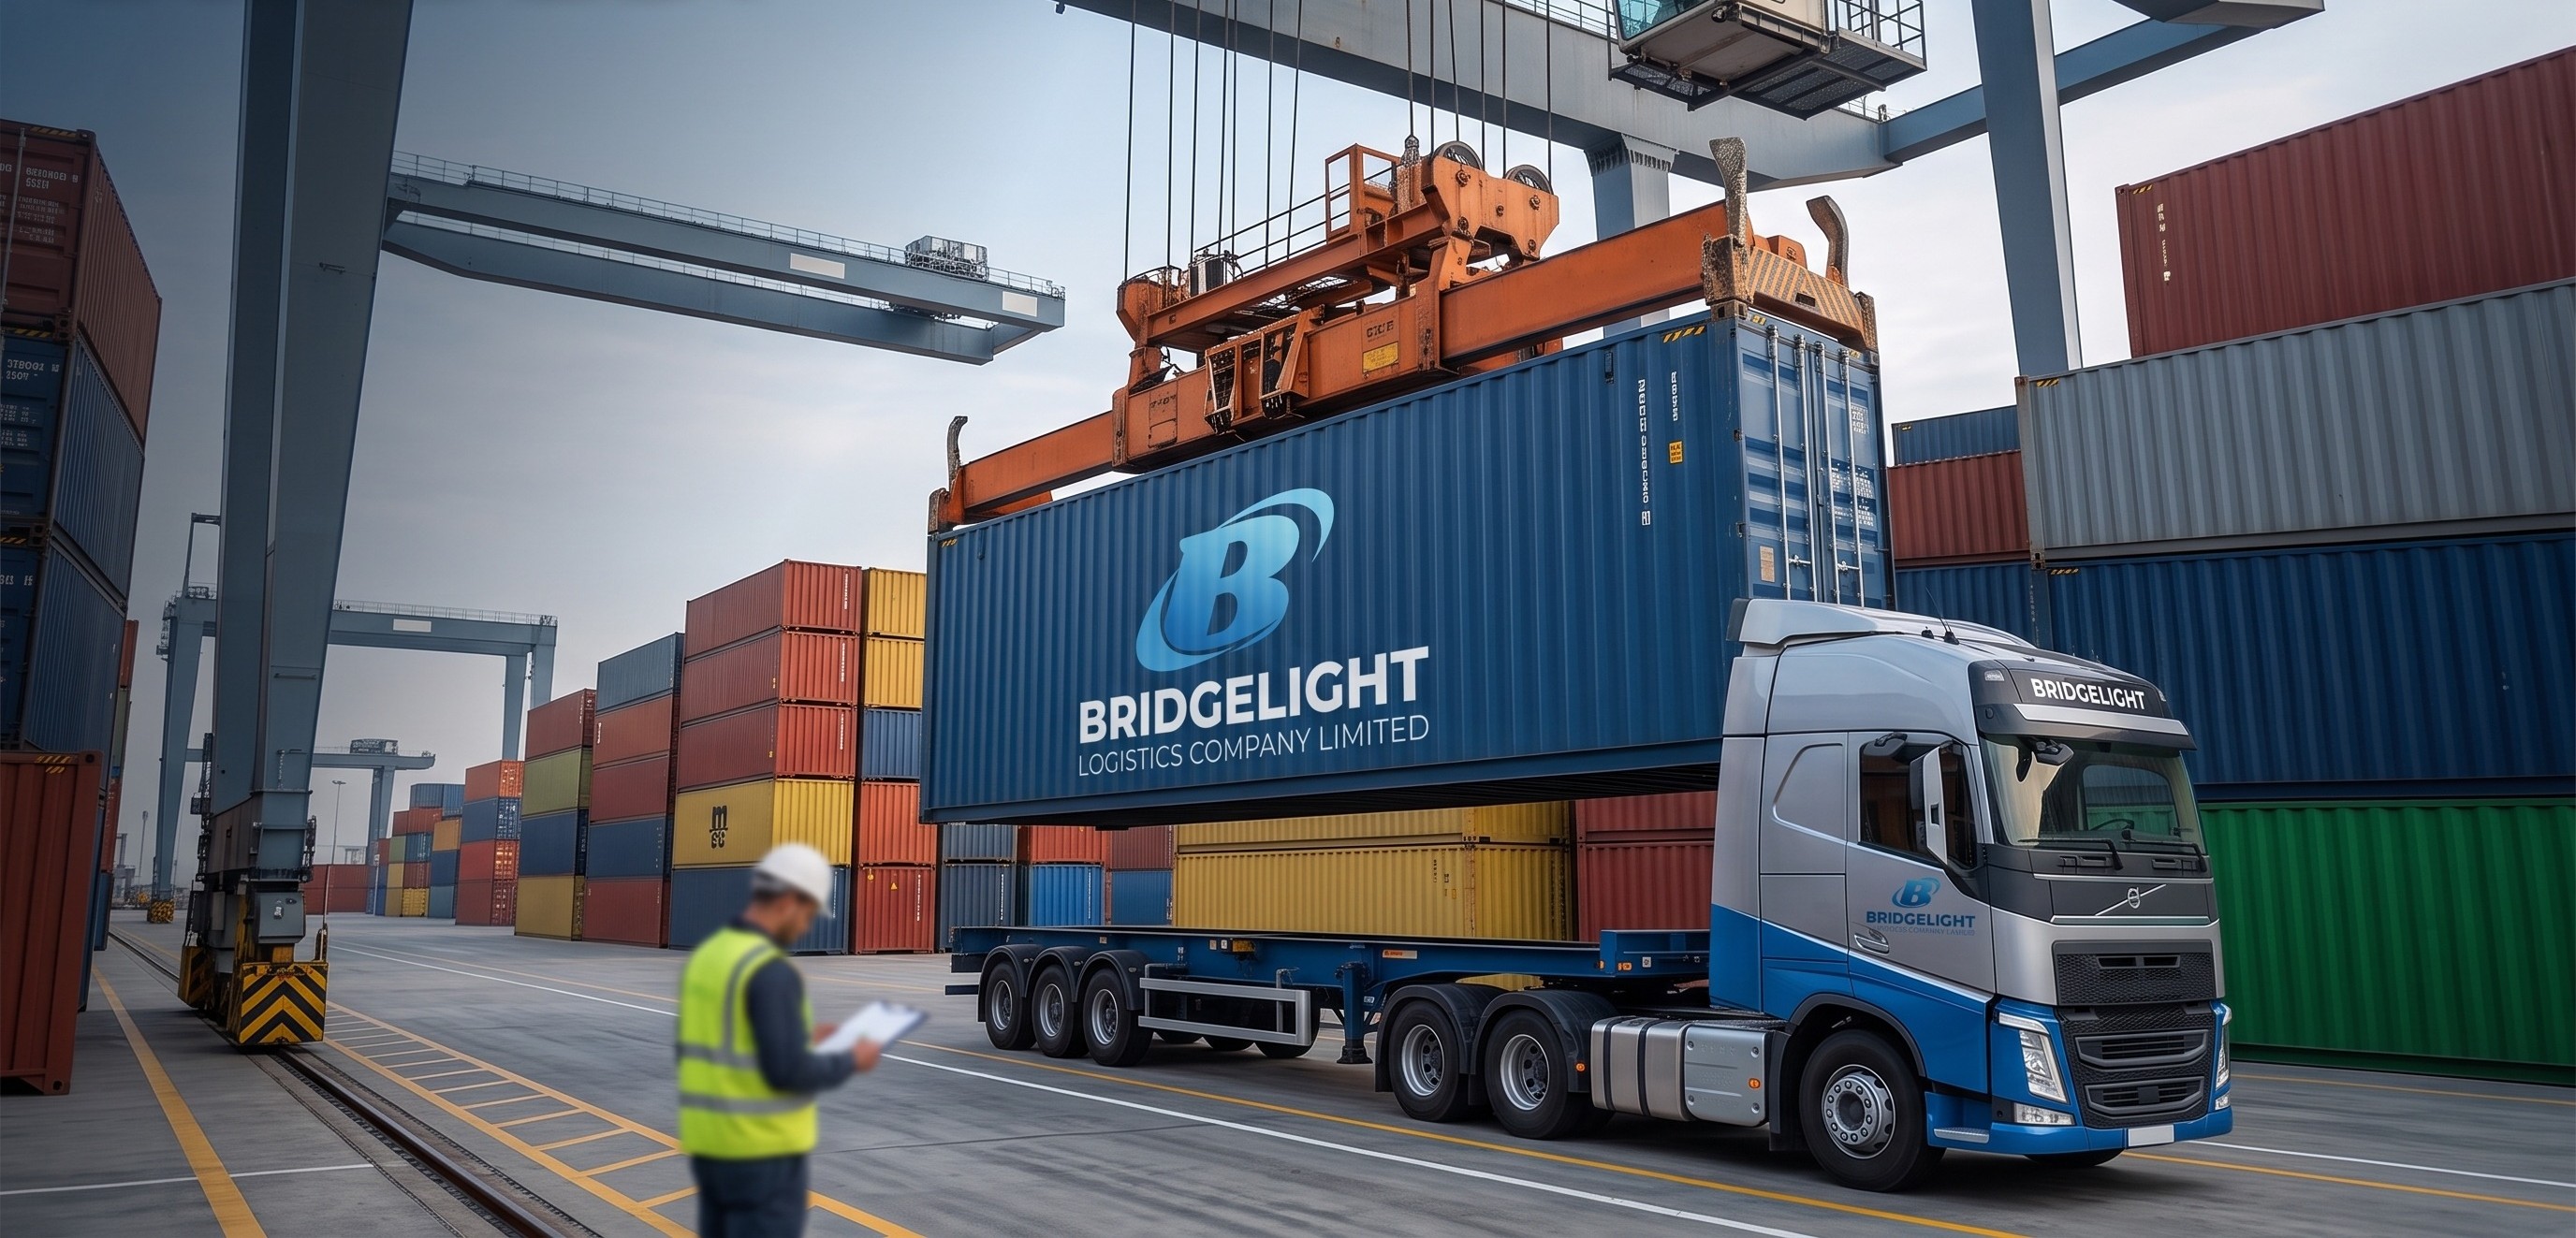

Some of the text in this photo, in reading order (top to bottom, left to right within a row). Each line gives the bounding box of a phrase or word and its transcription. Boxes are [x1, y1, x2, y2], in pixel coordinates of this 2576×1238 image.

[1164, 514, 1300, 652] B
[1079, 646, 1429, 744] BRIDGELIGHT
[2030, 677, 2145, 710] BRIDGELIGHT
[1078, 714, 1429, 777] LOGISTICS COMPANY LIMITED
[1899, 879, 1933, 907] B
[1866, 910, 1976, 928] BRIDGELIGHT
